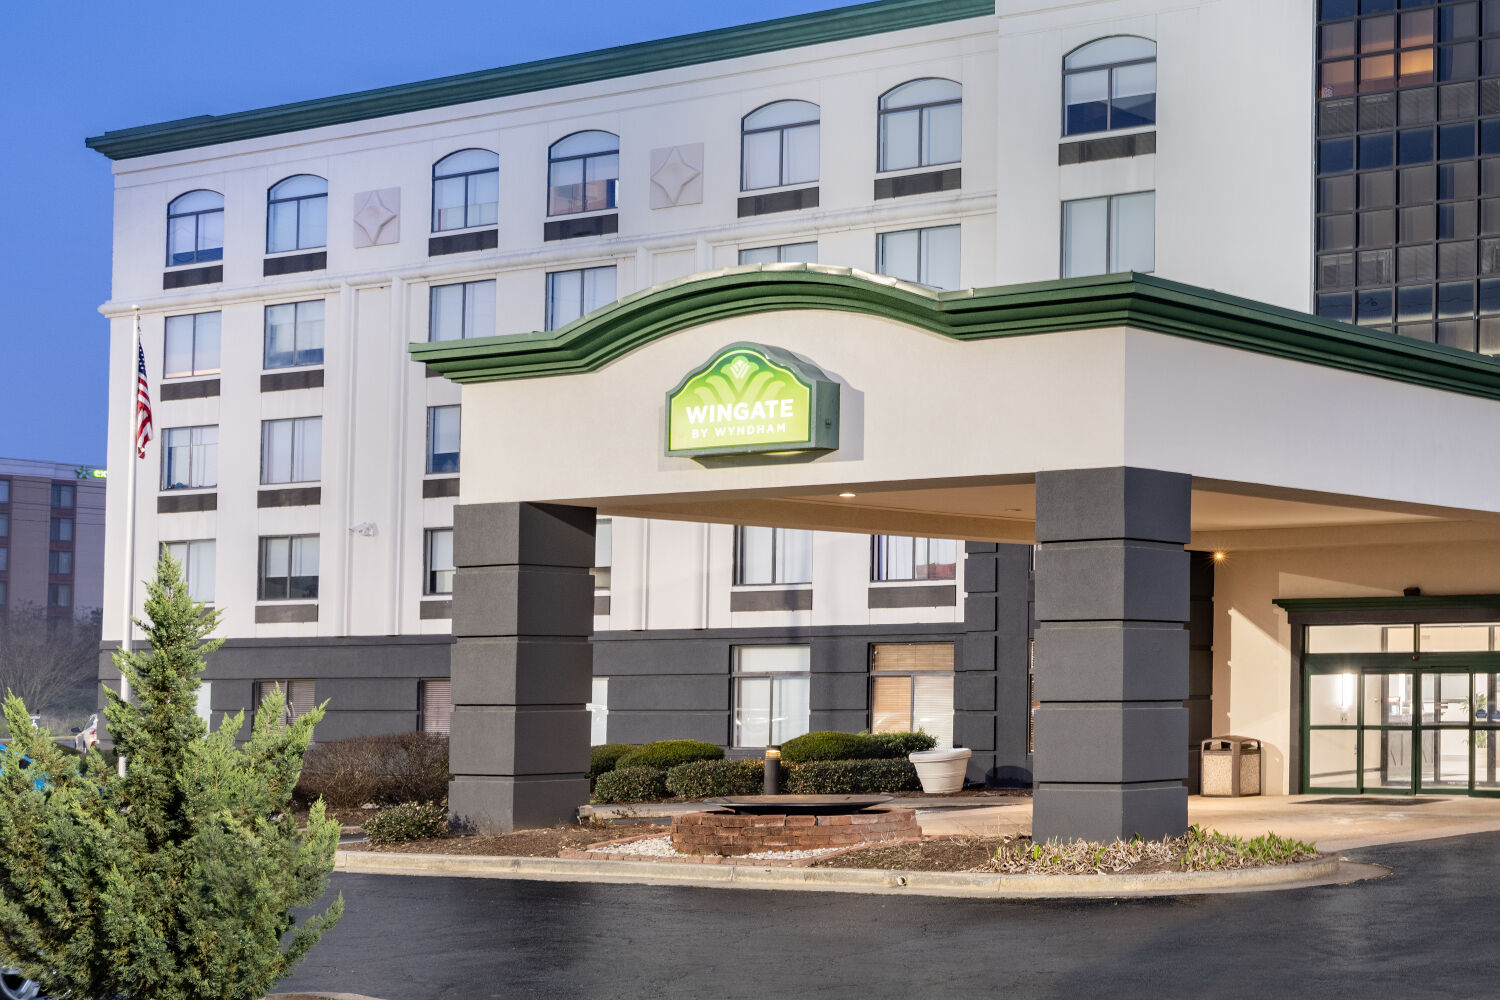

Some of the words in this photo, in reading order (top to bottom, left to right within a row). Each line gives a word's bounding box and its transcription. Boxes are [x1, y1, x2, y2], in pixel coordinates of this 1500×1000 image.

[686, 399, 794, 425] WINGATE
[691, 428, 708, 439] BY
[715, 423, 786, 437] WYNDHAM
